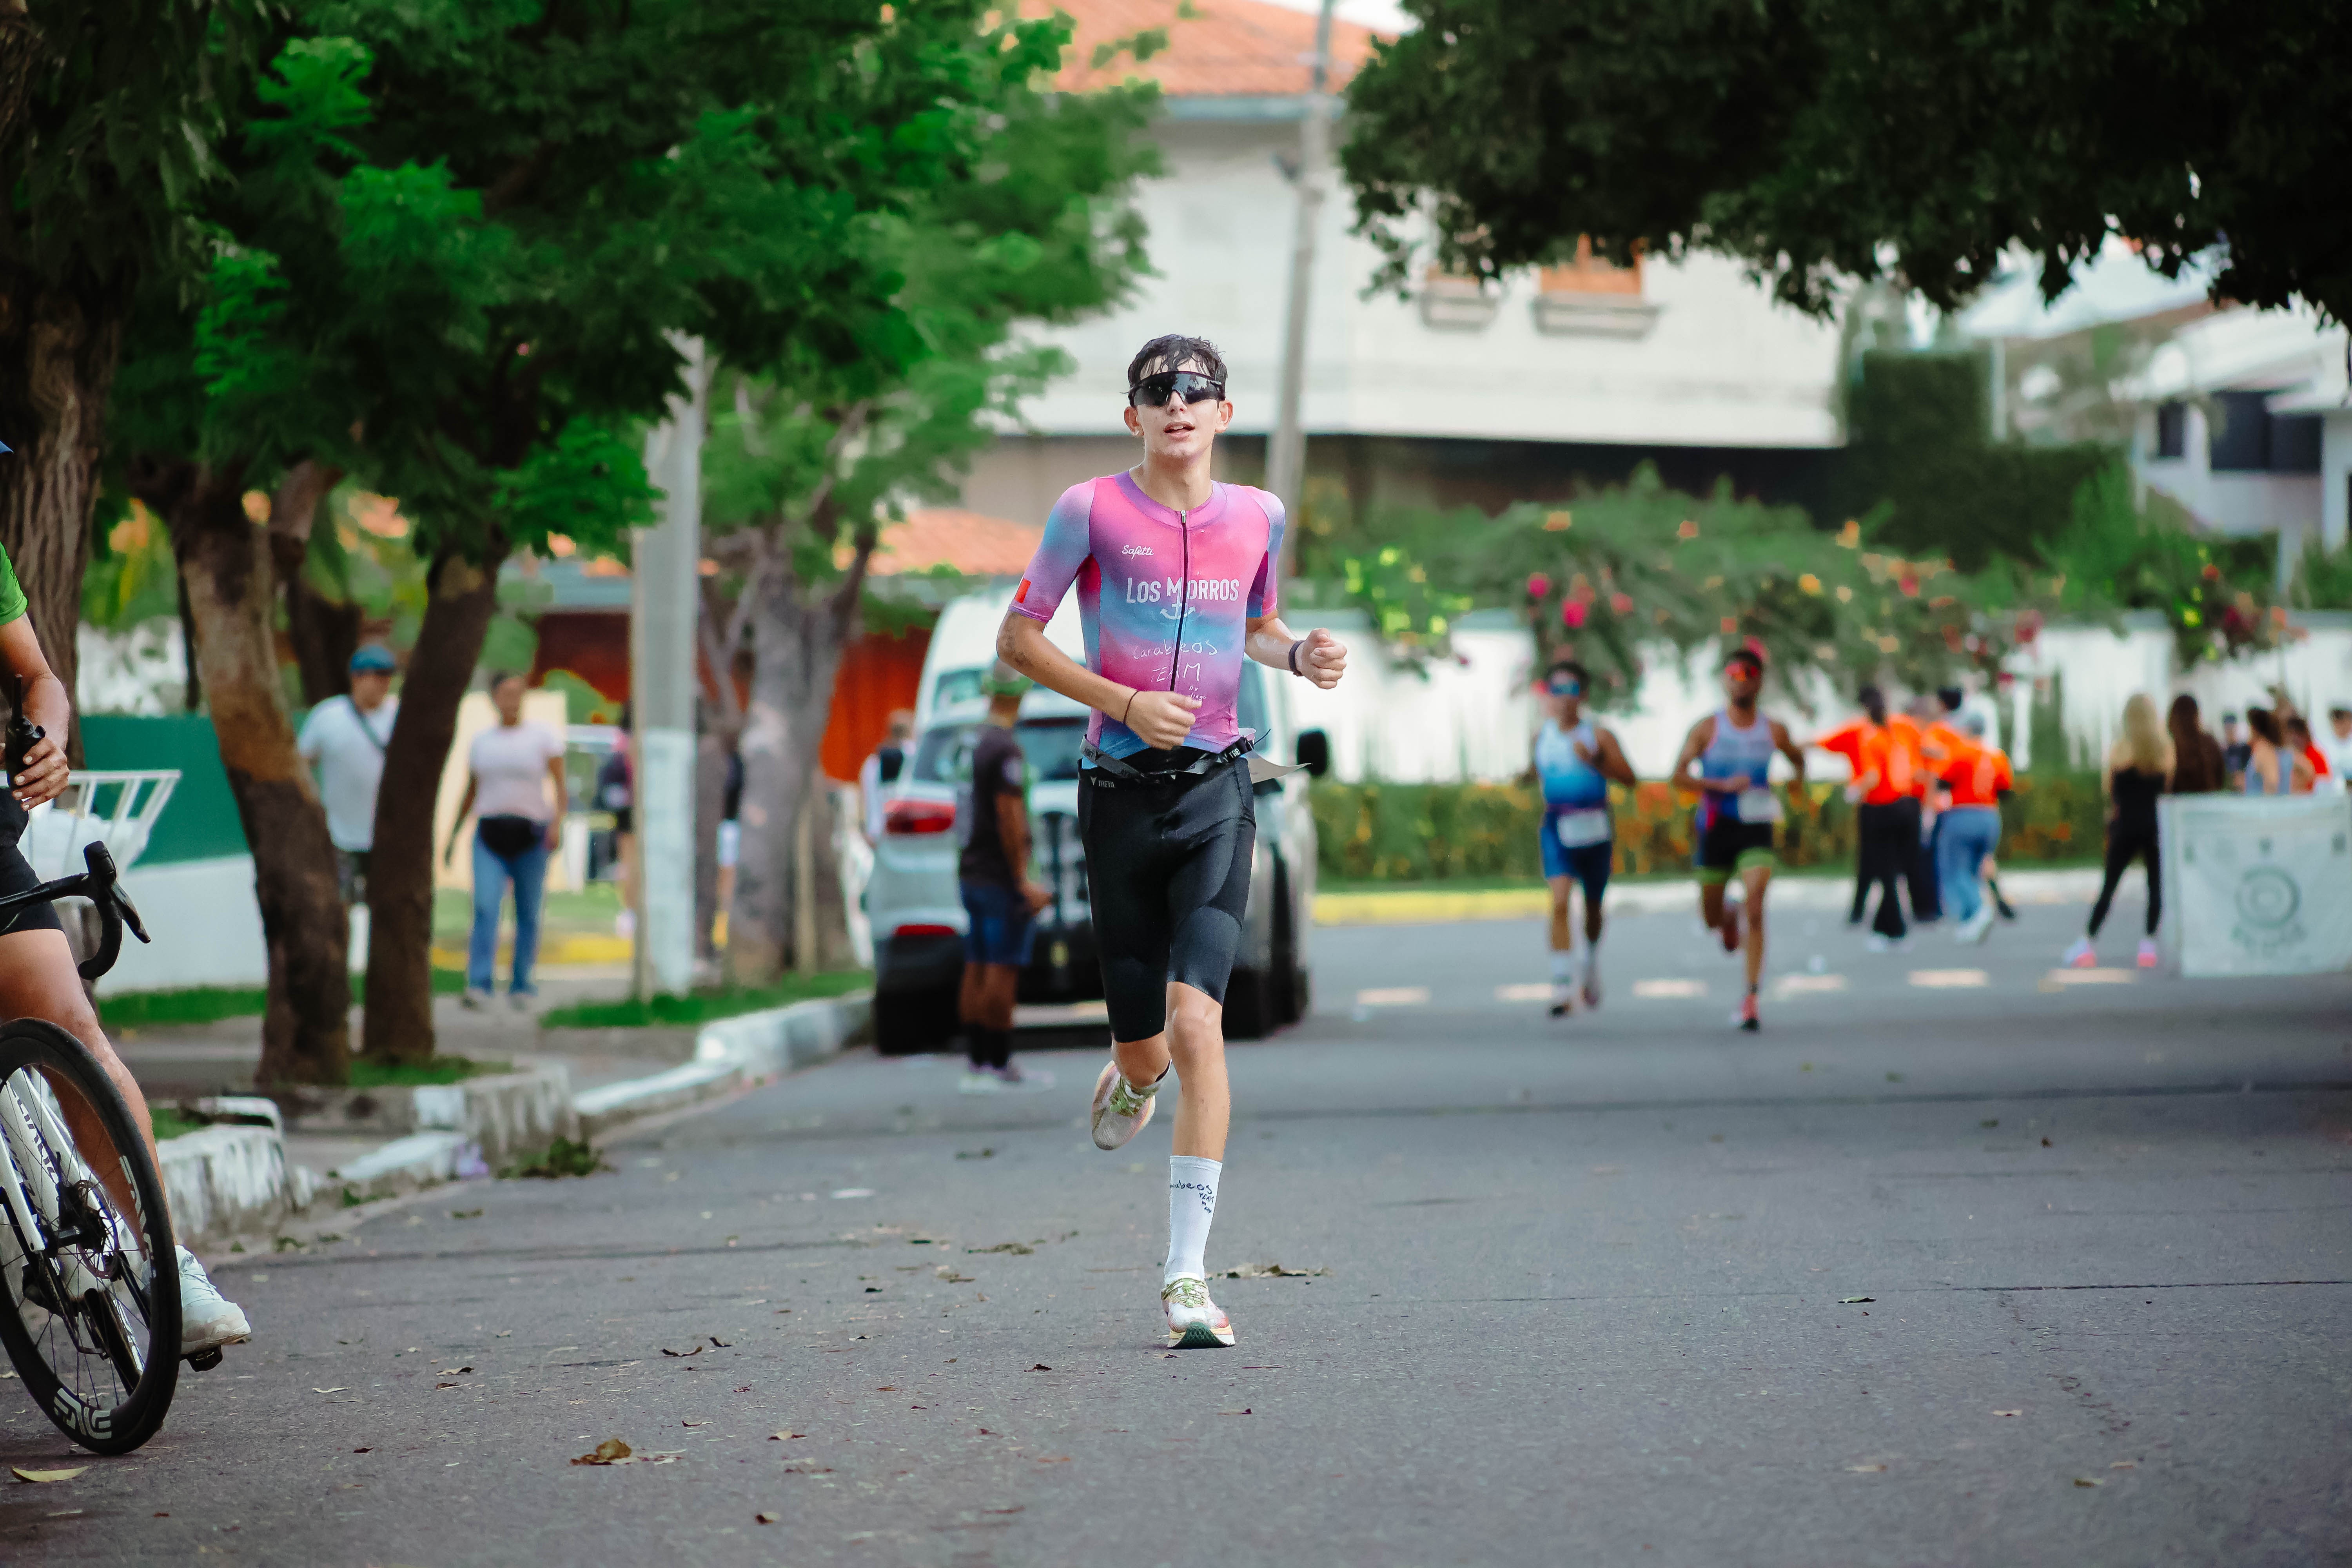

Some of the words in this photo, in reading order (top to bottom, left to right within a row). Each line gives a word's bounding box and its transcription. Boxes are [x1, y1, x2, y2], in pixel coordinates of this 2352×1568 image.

[1122, 545, 1154, 560] Safetti
[1126, 577, 1161, 603] LOS
[1166, 577, 1239, 601] MORROS
[1151, 663, 1200, 682] TEAM
